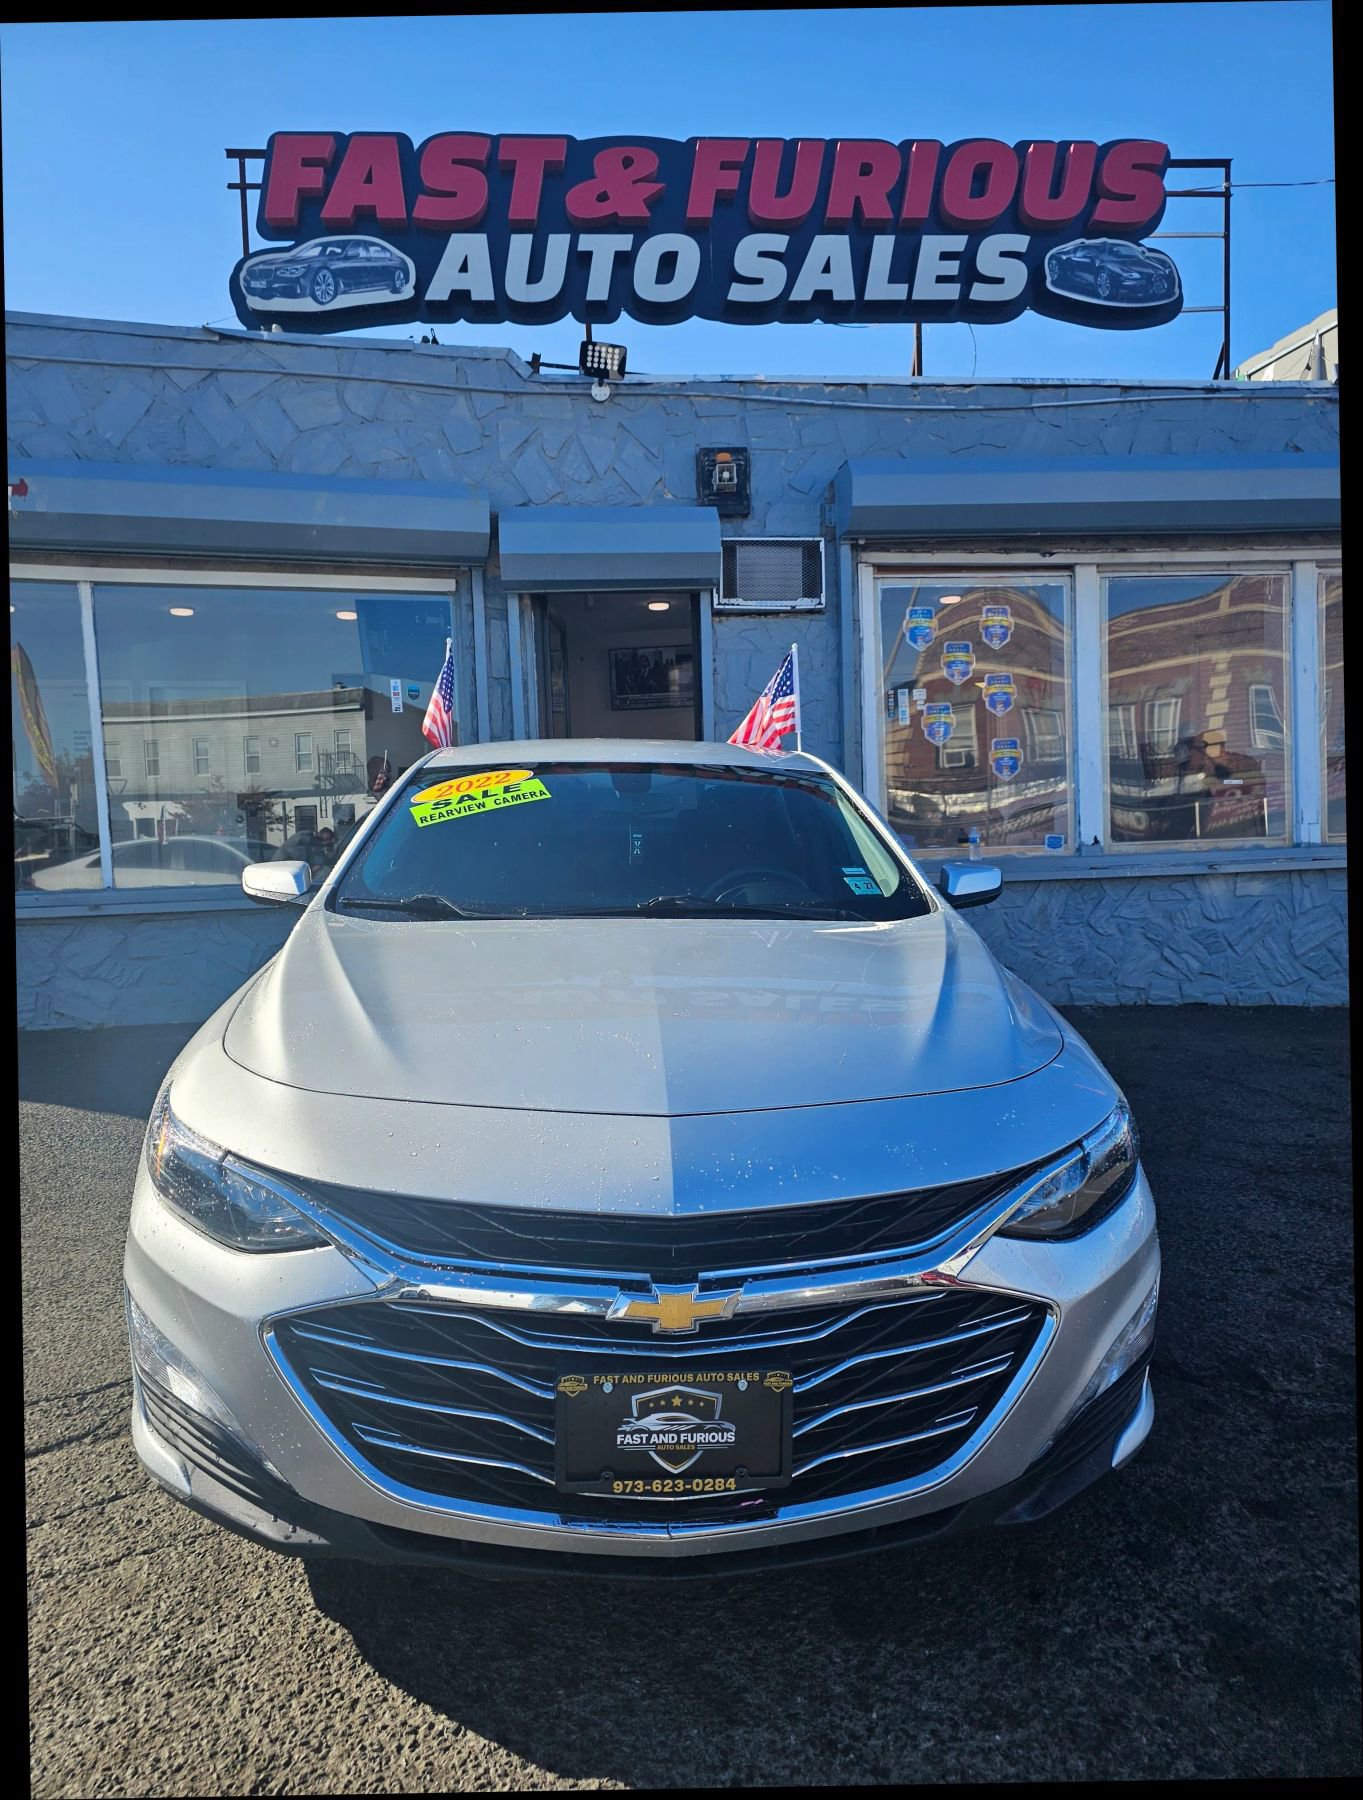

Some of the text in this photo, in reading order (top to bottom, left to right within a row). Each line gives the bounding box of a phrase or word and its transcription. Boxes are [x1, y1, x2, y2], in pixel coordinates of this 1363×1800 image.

[265, 134, 1169, 230] FAST & FURIOUS
[425, 233, 1031, 303] AUTO SALES
[431, 783, 522, 811] SALE
[435, 772, 512, 799] 2022
[419, 789, 548, 824] REARVIEW CAMERA
[593, 1371, 760, 1385] FAST AND FURIOUS AUTO SALES
[616, 1431, 736, 1445] FAST AND FURIOUS
[612, 1477, 737, 1494] 973-623-0284
